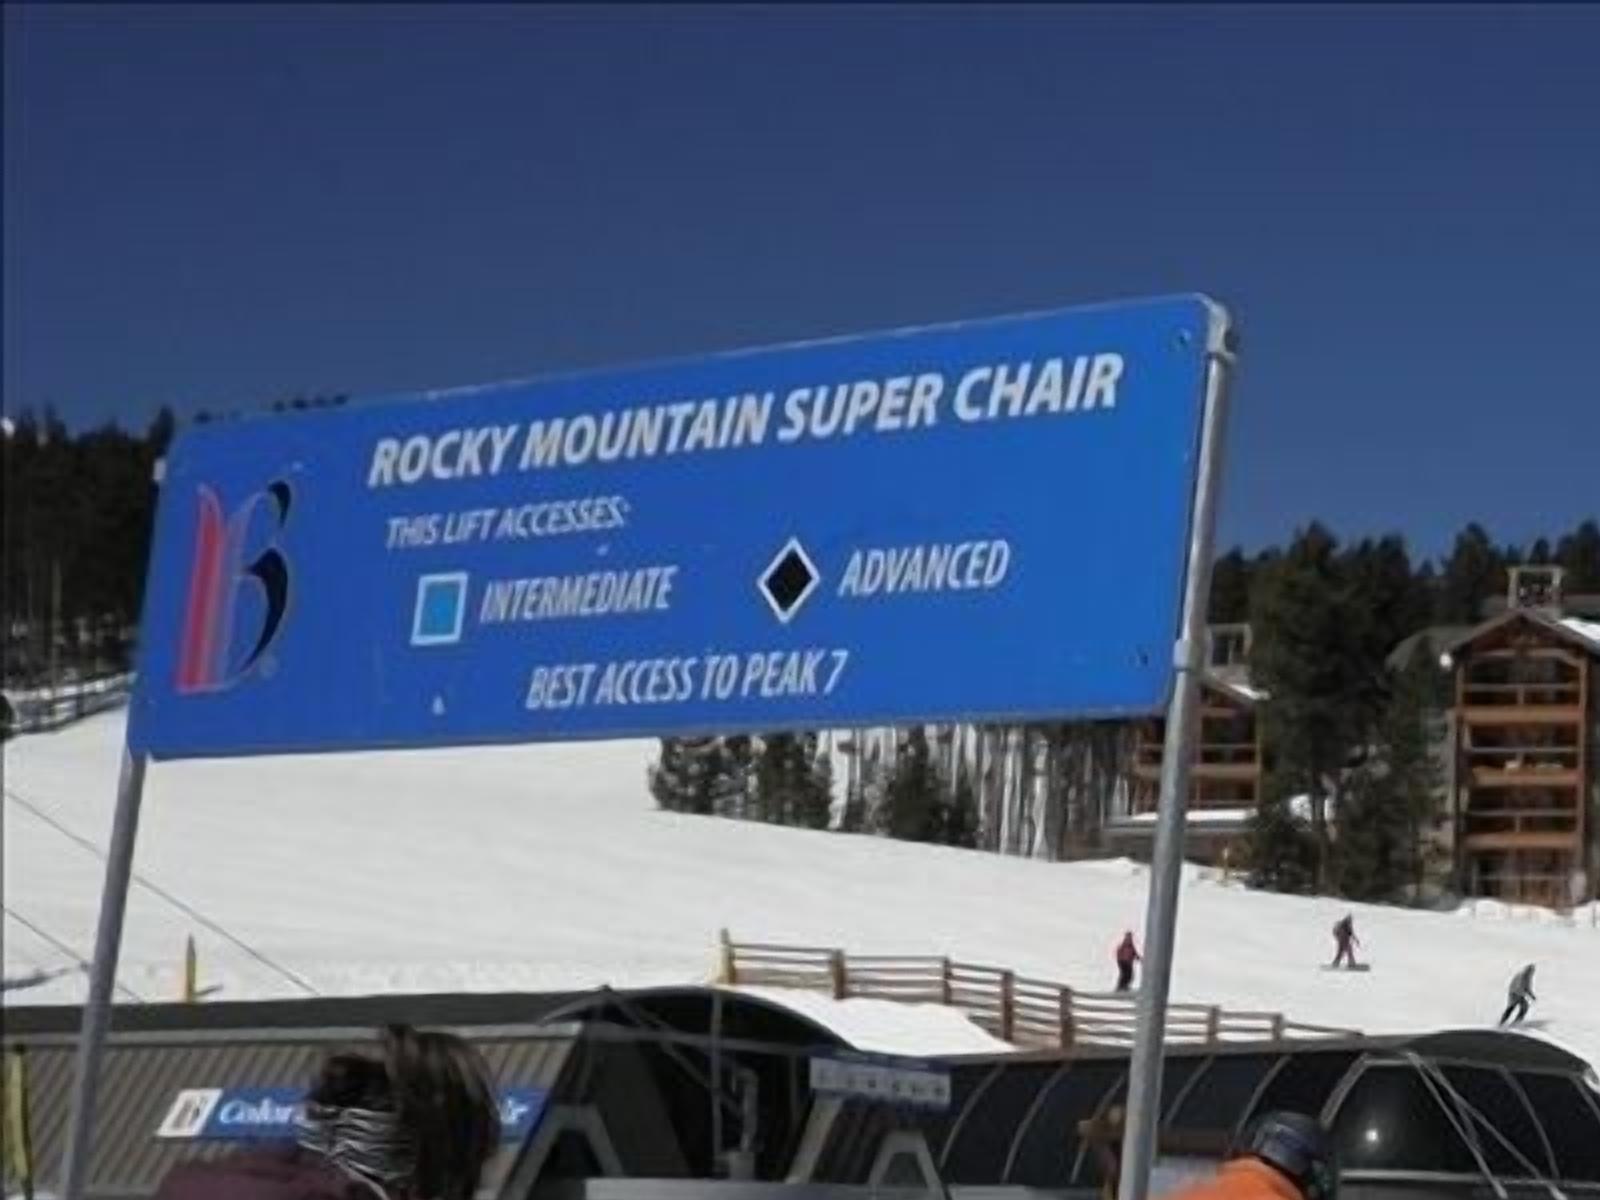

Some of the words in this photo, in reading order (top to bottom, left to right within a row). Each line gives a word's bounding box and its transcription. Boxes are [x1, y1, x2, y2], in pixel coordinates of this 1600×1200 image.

[367, 425, 518, 487] ROCKY
[520, 393, 773, 469] MOUNTAIN
[777, 373, 945, 443] SUPER
[952, 351, 1124, 421] CHAIR
[386, 513, 441, 550] THIS
[443, 508, 496, 543] LIFT
[480, 565, 679, 623] INTERMEDIATE
[838, 540, 1011, 596] ADVANCED
[524, 663, 597, 711] BEST
[594, 656, 698, 708] ACCESS
[700, 652, 740, 701] TO
[740, 651, 822, 697] PEAK
[822, 649, 848, 694] 7
